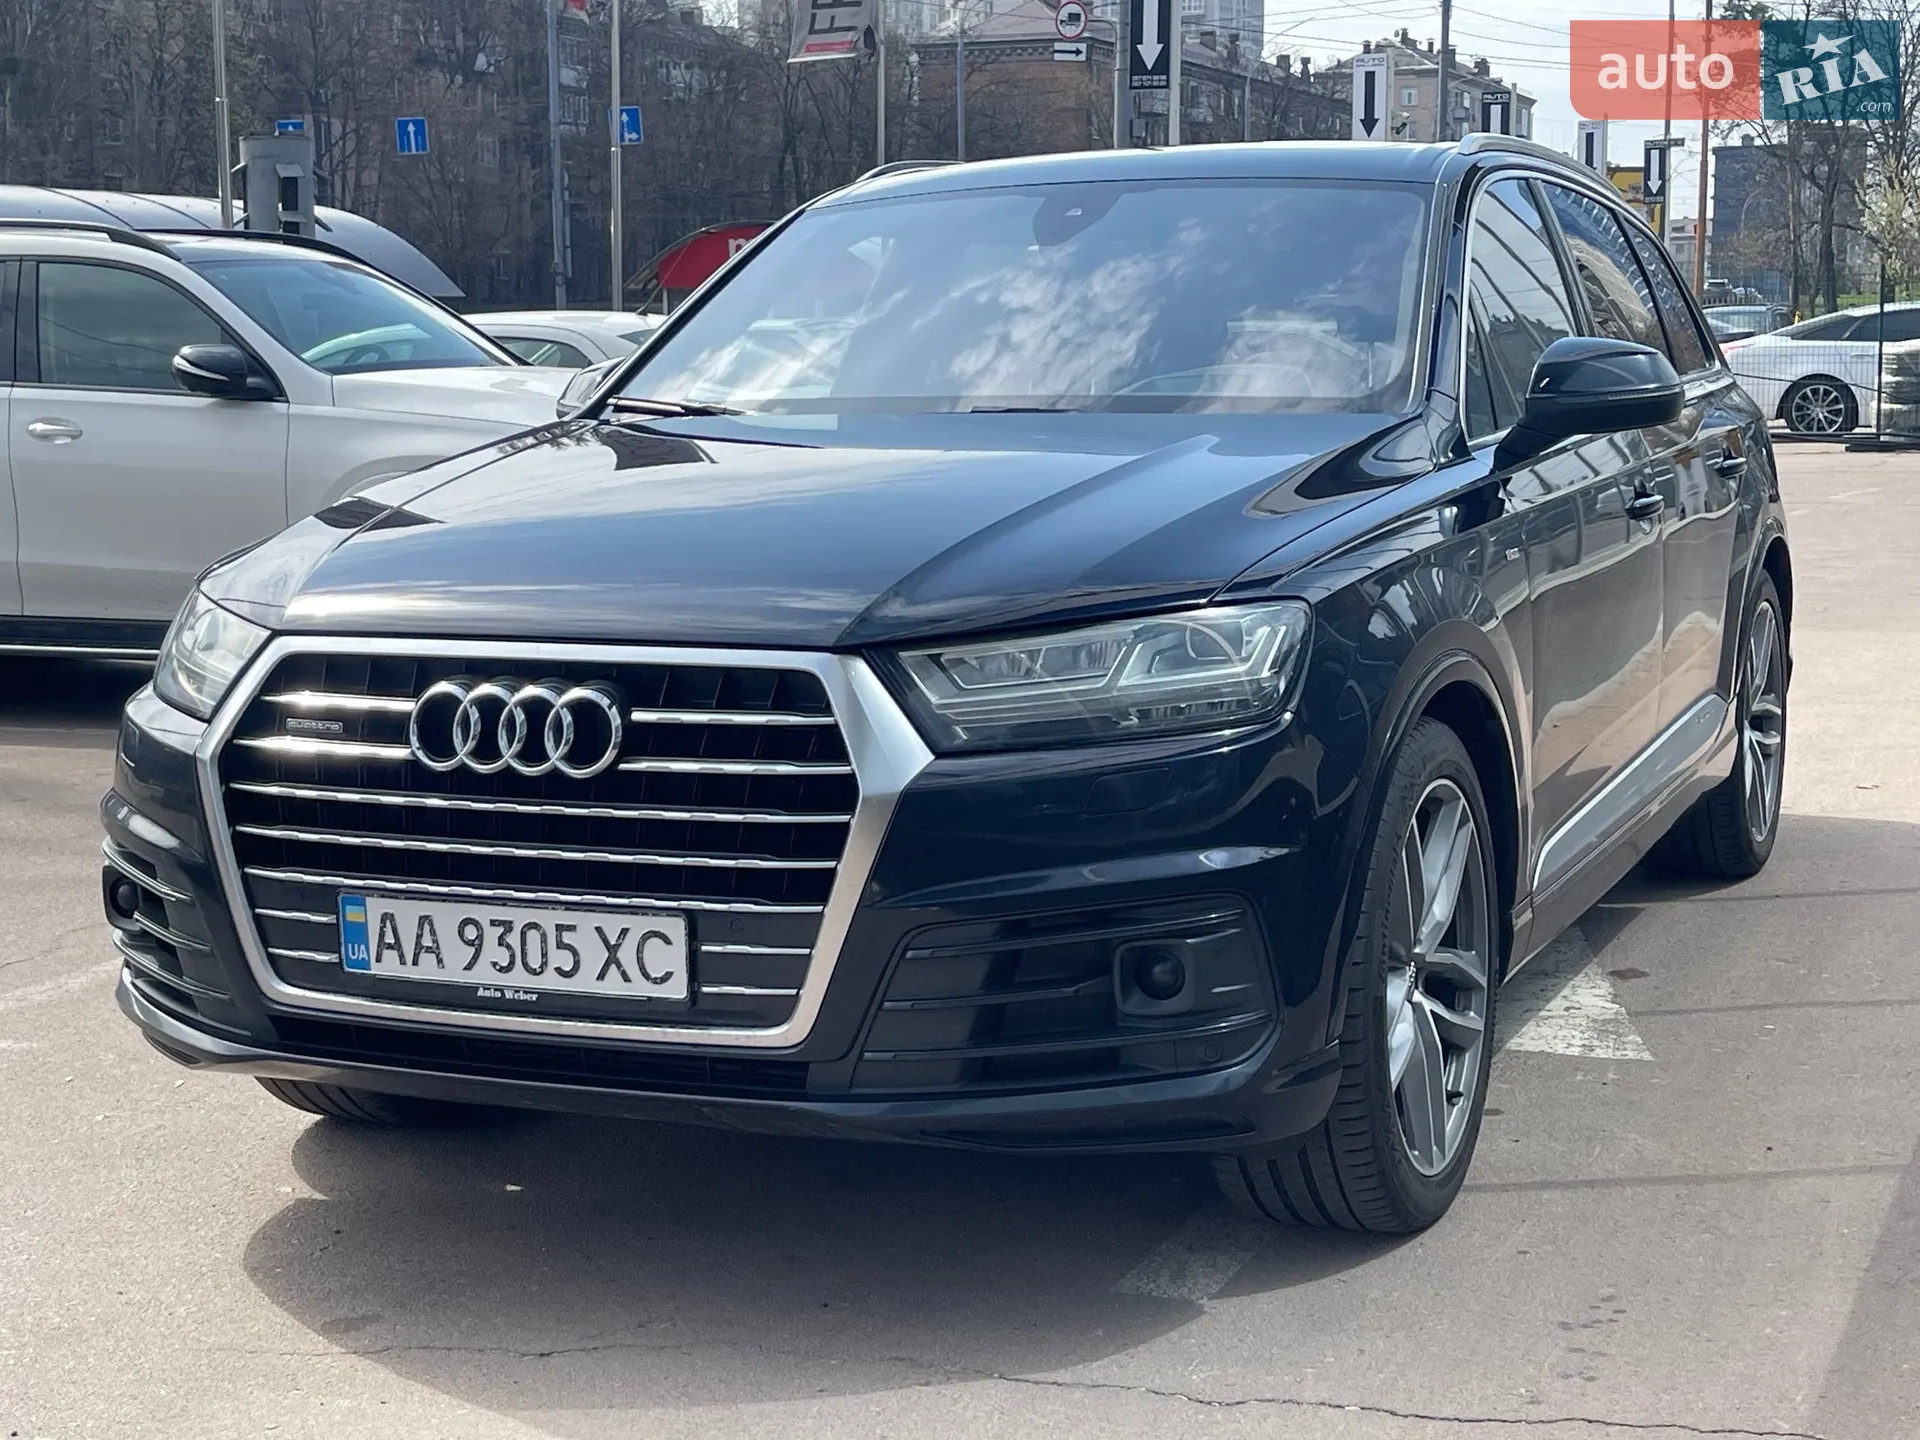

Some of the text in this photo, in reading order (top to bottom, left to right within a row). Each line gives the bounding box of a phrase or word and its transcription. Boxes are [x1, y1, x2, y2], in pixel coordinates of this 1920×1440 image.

[287, 721, 340, 730] quattro
[348, 943, 368, 961] UA
[375, 911, 674, 985] AA 9305 XC
[477, 987, 538, 1001] Auto Weber
